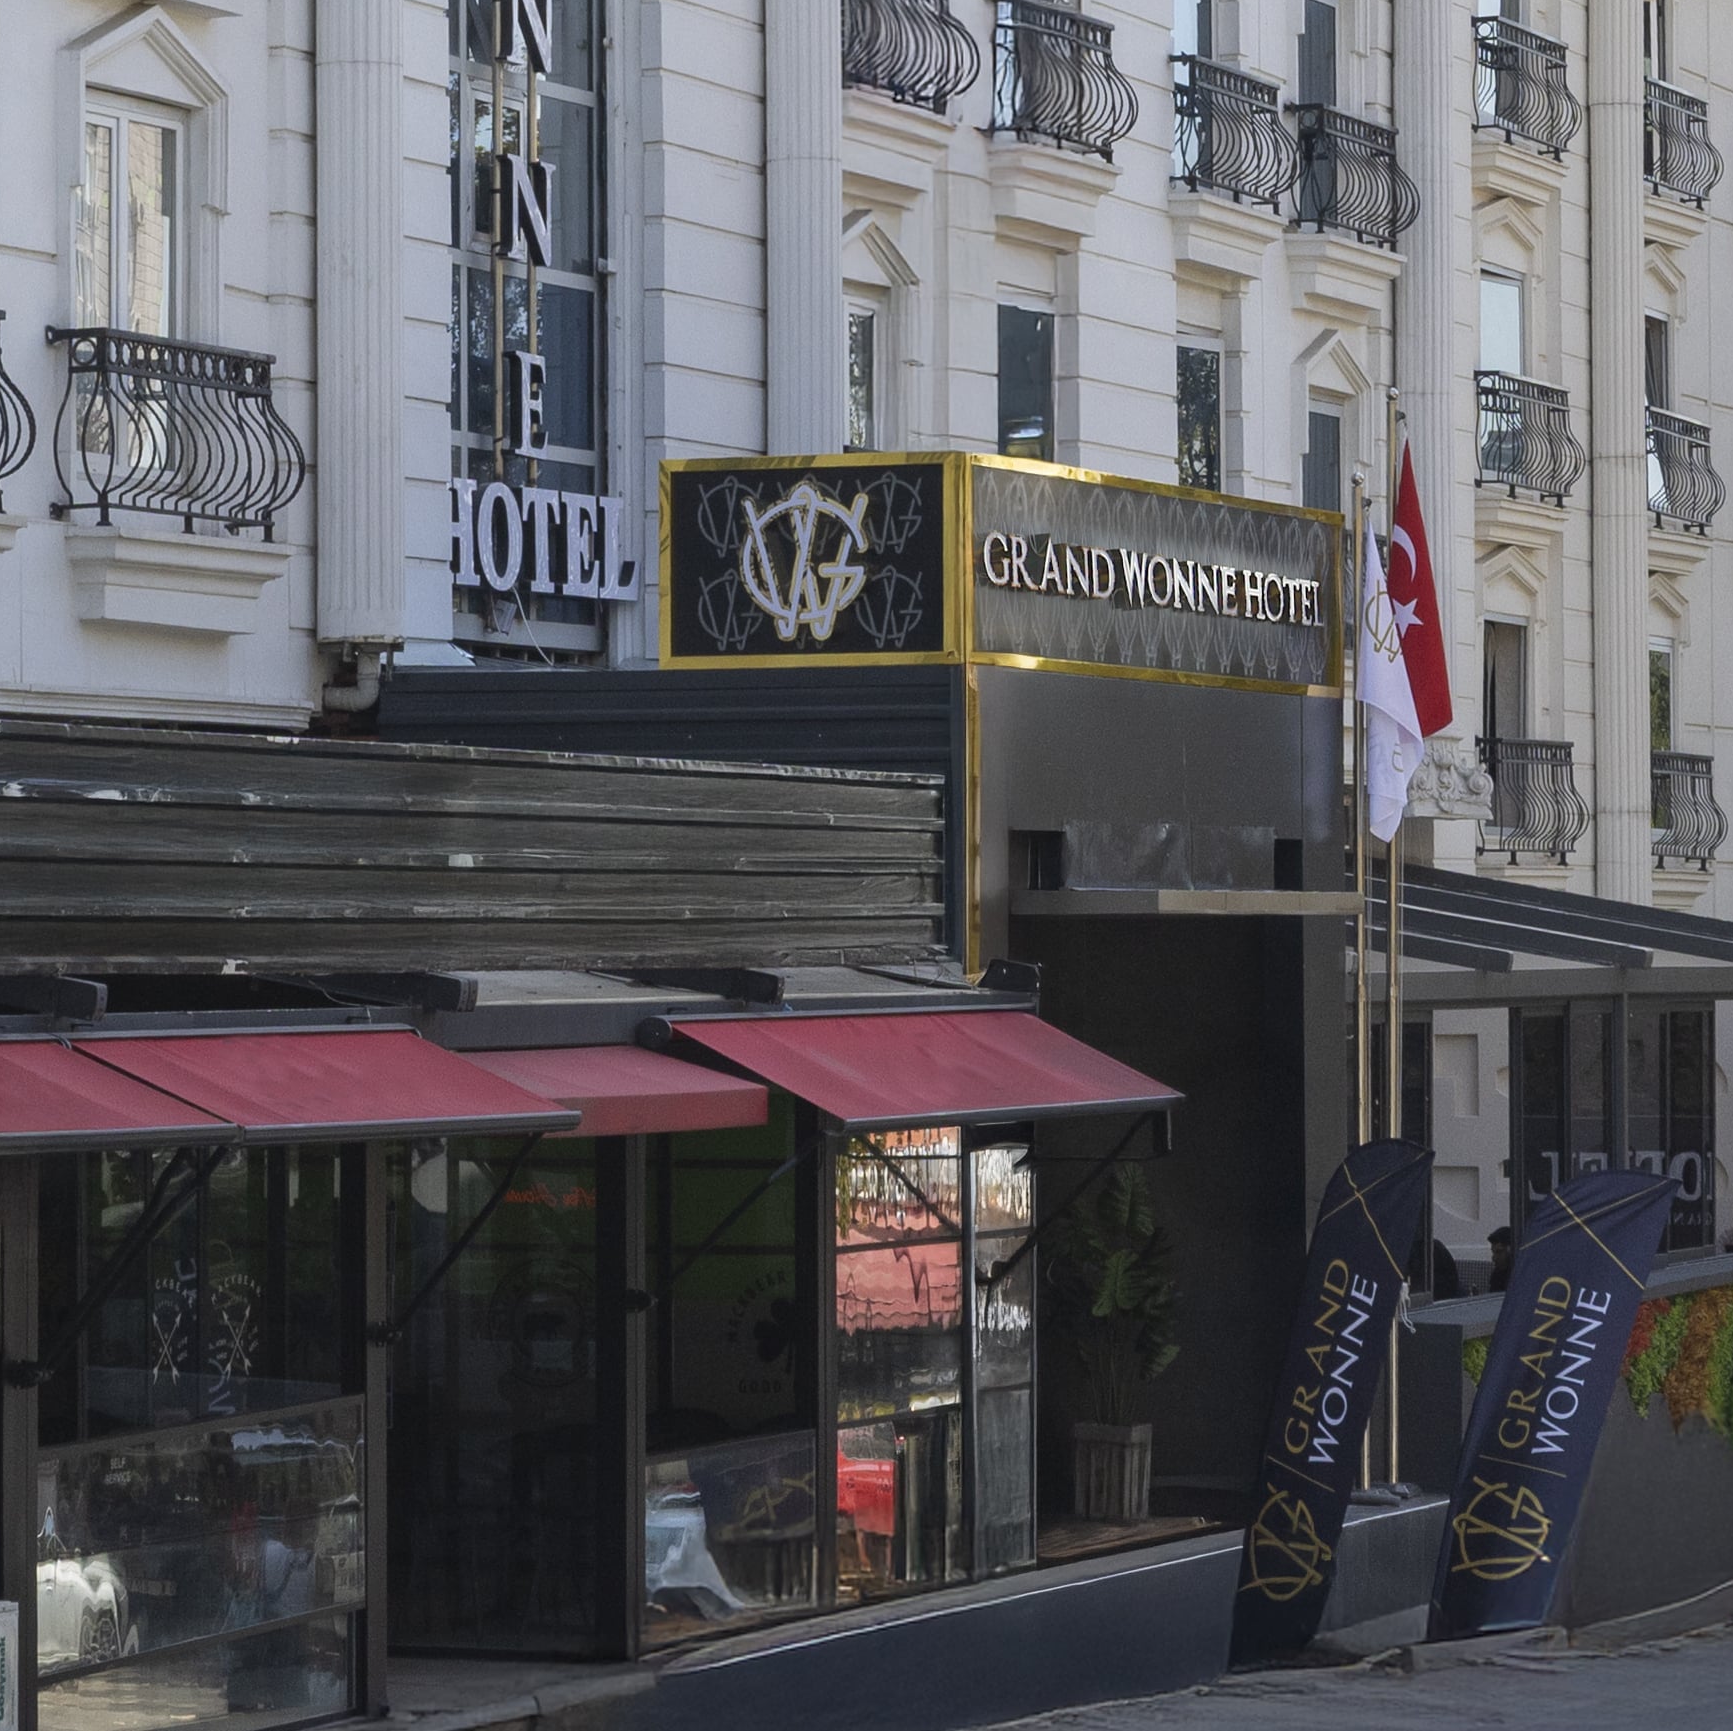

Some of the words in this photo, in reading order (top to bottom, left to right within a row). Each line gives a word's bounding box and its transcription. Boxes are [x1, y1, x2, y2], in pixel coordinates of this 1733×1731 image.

[447, 477, 638, 601] HOTEL
[983, 531, 1115, 600] GRAND
[1119, 548, 1238, 618] WONNE
[1242, 569, 1325, 628] HOTEL
[1284, 1258, 1350, 1455] GRAND
[1308, 1274, 1379, 1465] WONNE
[1498, 1275, 1573, 1450] GRAND
[1531, 1287, 1612, 1456] WONNE
